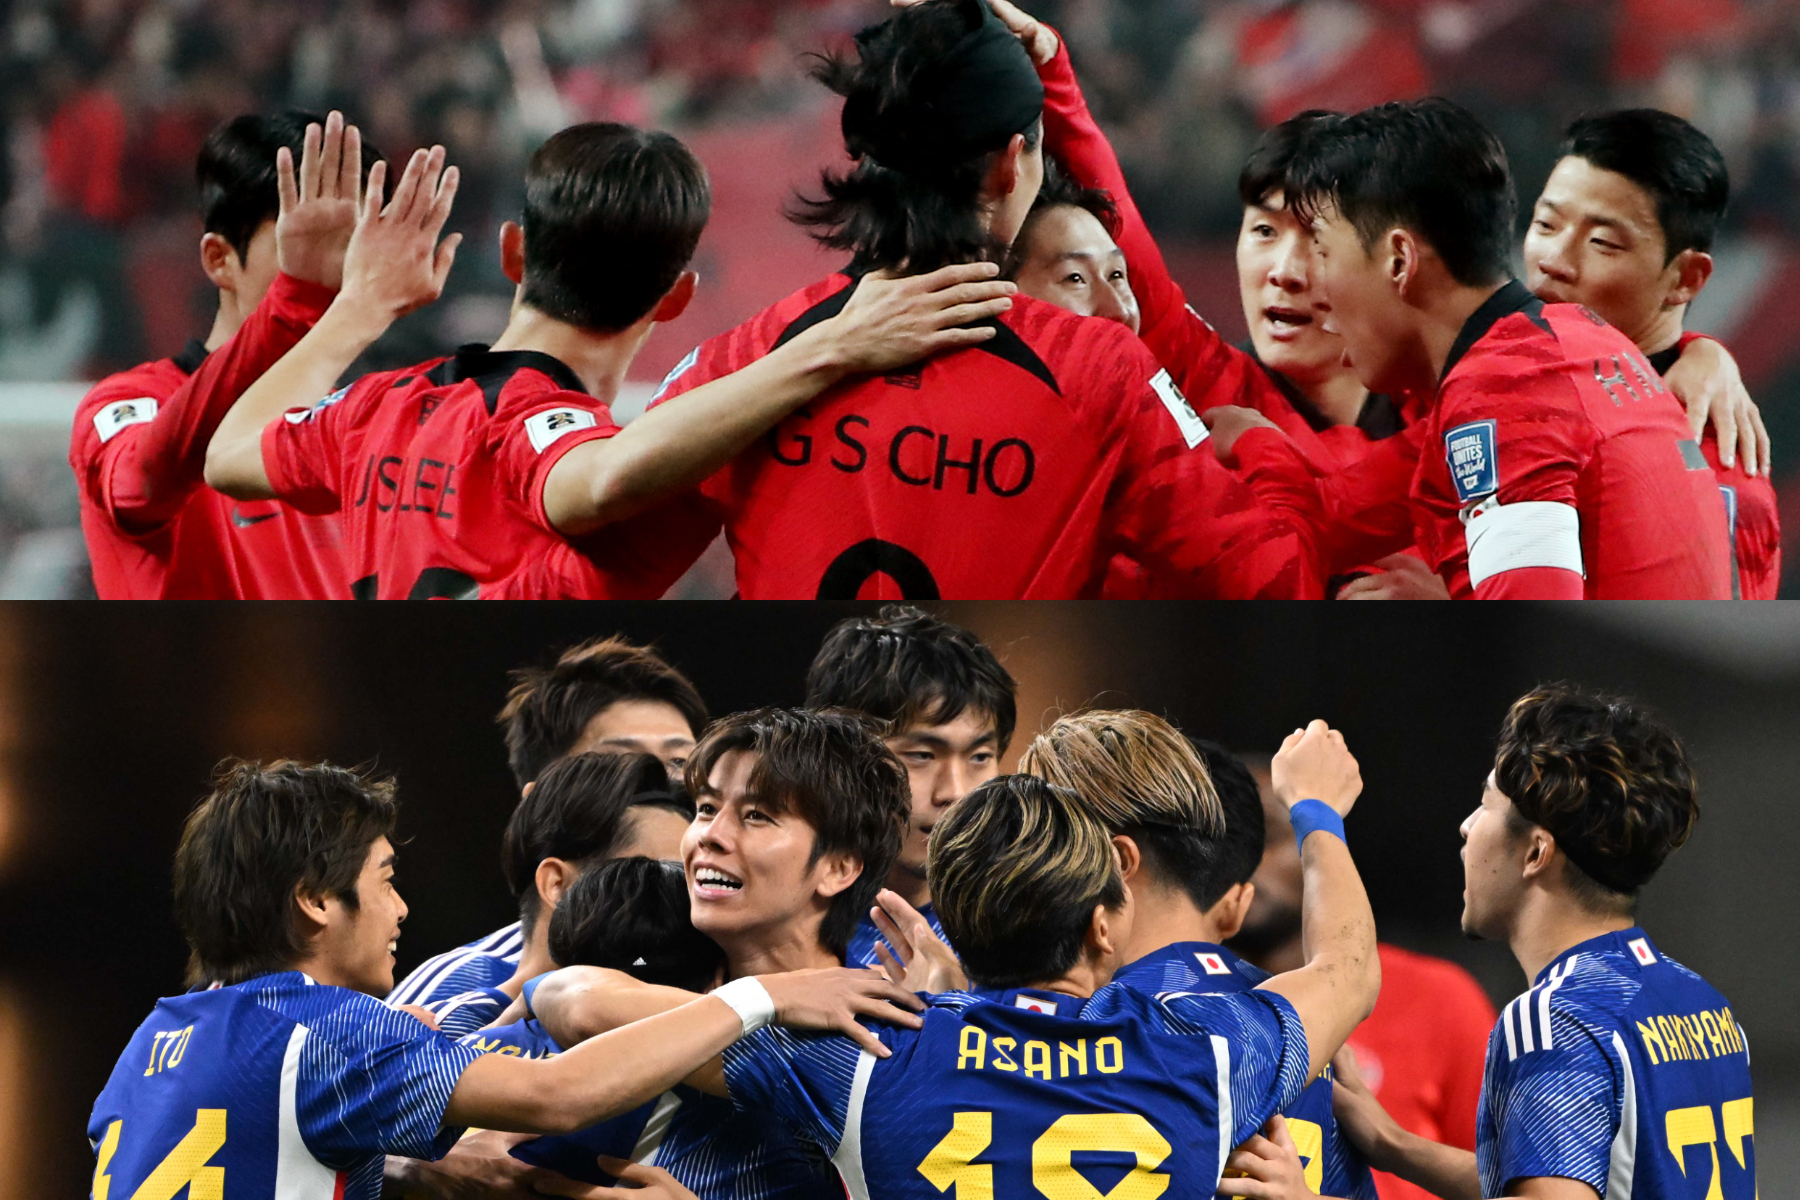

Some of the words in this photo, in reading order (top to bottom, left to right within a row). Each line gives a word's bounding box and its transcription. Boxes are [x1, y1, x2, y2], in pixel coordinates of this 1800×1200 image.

[770, 409, 812, 466] G
[831, 414, 869, 473] S
[889, 425, 1035, 497] CHO
[143, 1024, 194, 1077] ITO
[957, 1025, 1124, 1080] ASANO
